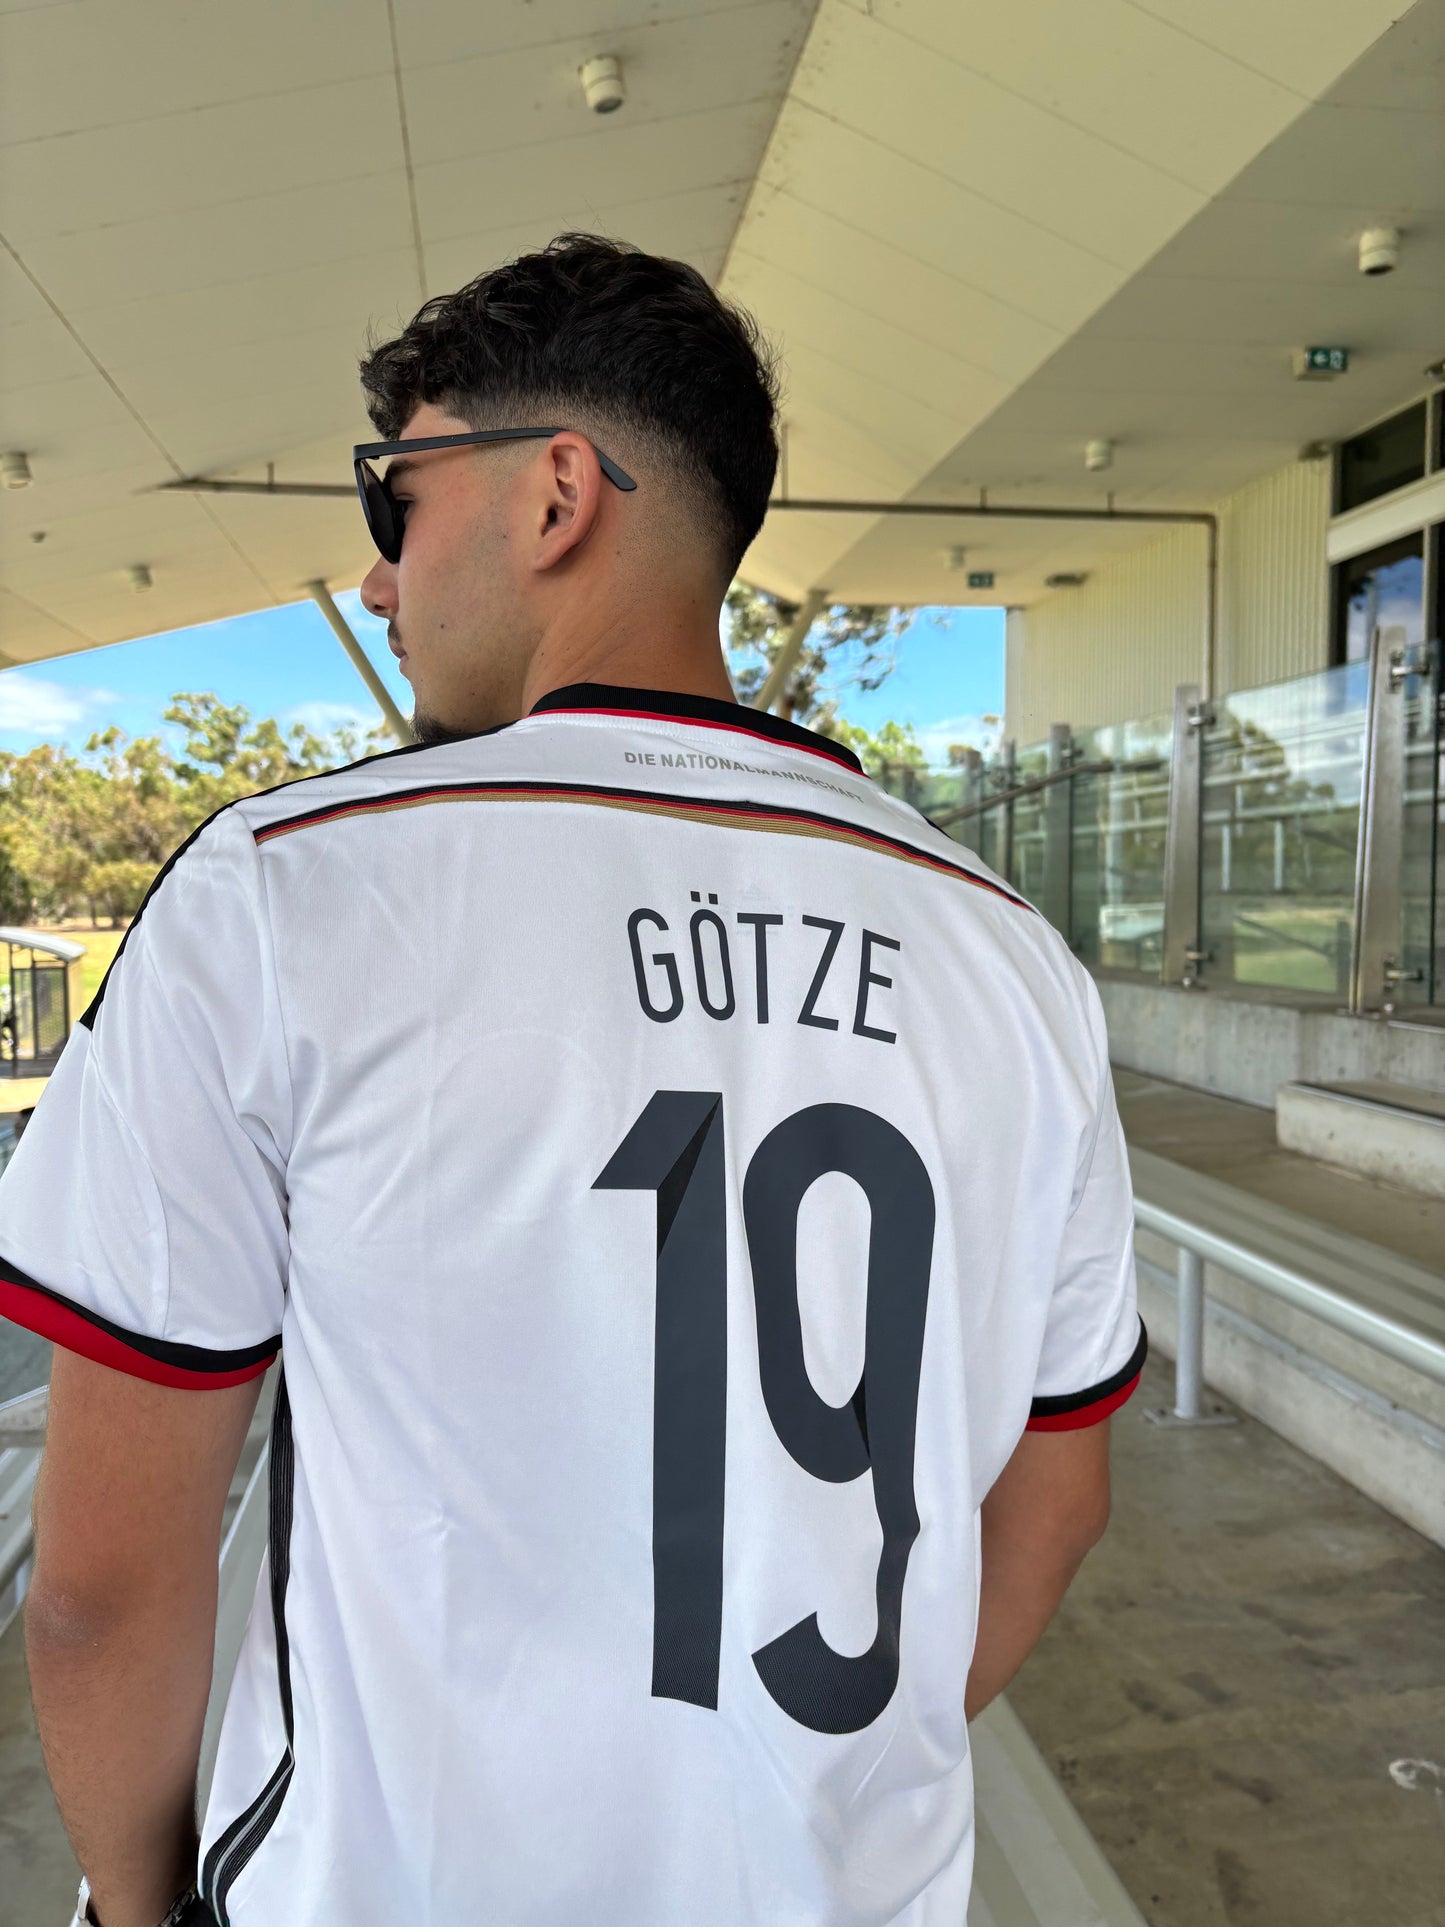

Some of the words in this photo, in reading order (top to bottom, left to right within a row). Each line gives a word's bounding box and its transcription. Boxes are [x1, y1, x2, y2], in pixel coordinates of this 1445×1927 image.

[625, 752, 656, 766] DIE
[661, 754, 864, 803] NATIONALMANNSCHAFT
[627, 890, 901, 1045] GÖTZE
[590, 1089, 936, 1735] 19
